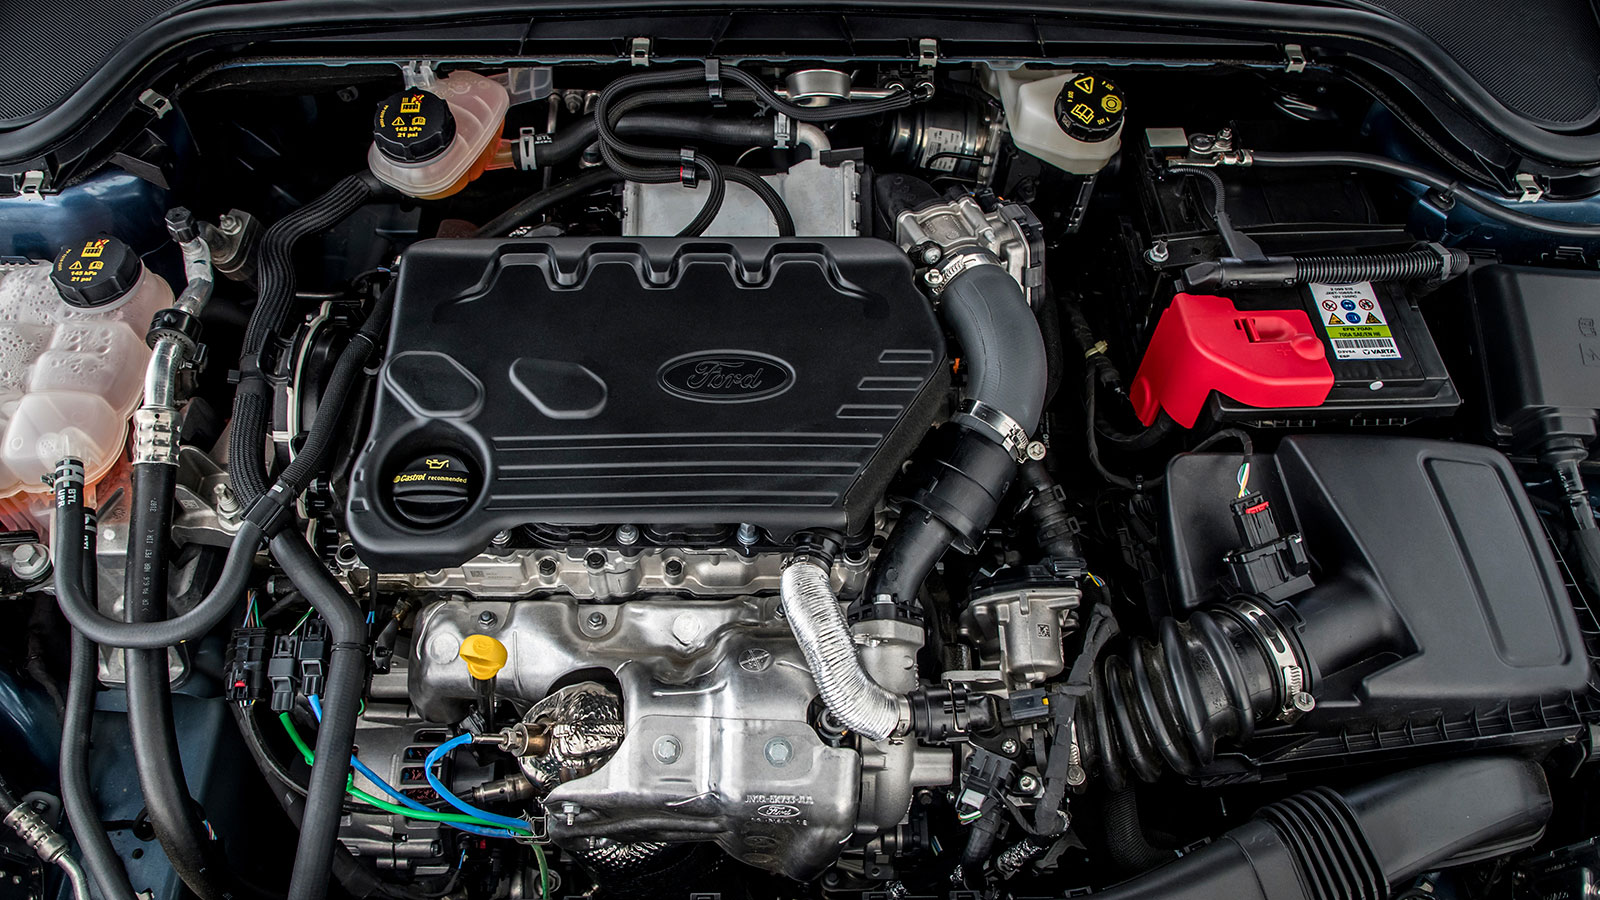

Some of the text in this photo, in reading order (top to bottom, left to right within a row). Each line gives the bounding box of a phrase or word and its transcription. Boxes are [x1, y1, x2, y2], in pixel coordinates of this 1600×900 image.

[686, 360, 764, 389] Ford
[400, 473, 468, 484] Castrol recommended
[57, 488, 66, 508] UPR
[67, 488, 77, 505] BTL
[144, 549, 153, 559] PET
[766, 805, 791, 816] Ford
